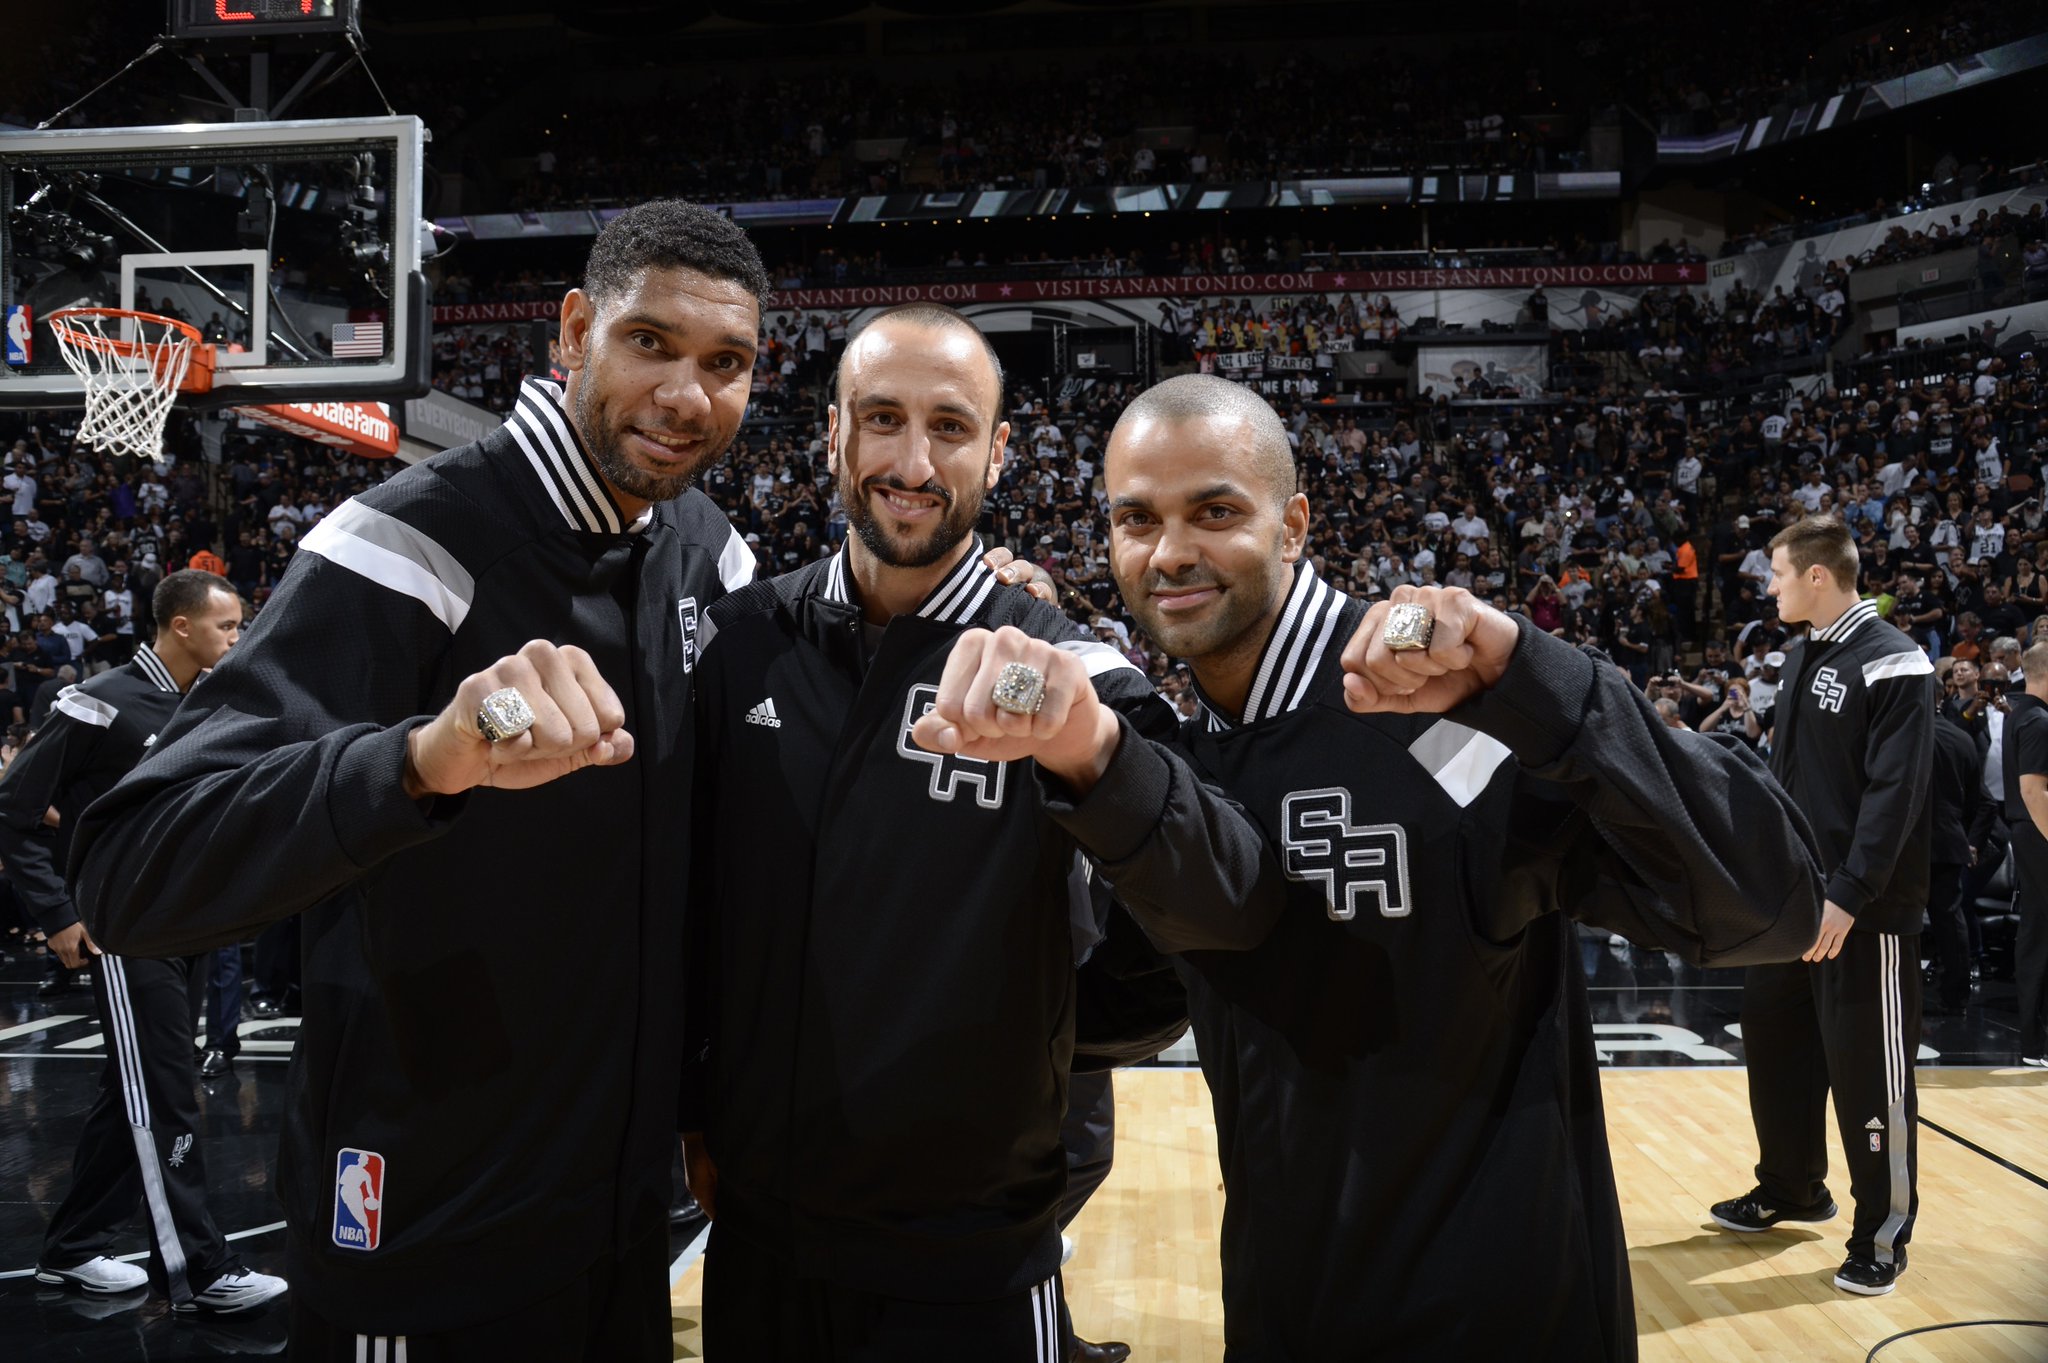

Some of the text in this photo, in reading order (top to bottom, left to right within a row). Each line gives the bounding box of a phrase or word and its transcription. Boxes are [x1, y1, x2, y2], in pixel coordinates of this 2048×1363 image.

[1035, 273, 1315, 297] VISITSANANTONIO.COM
[1370, 265, 1655, 287] VISITSANANTONIO.COM
[770, 284, 978, 307] SANANTONIO.COM
[432, 300, 562, 320] ITSANANTO
[1267, 357, 1312, 369] STARTS
[1811, 666, 1848, 714] SA
[745, 714, 782, 729] adidas
[1281, 787, 1412, 921] SA
[338, 1225, 365, 1243] NBA
